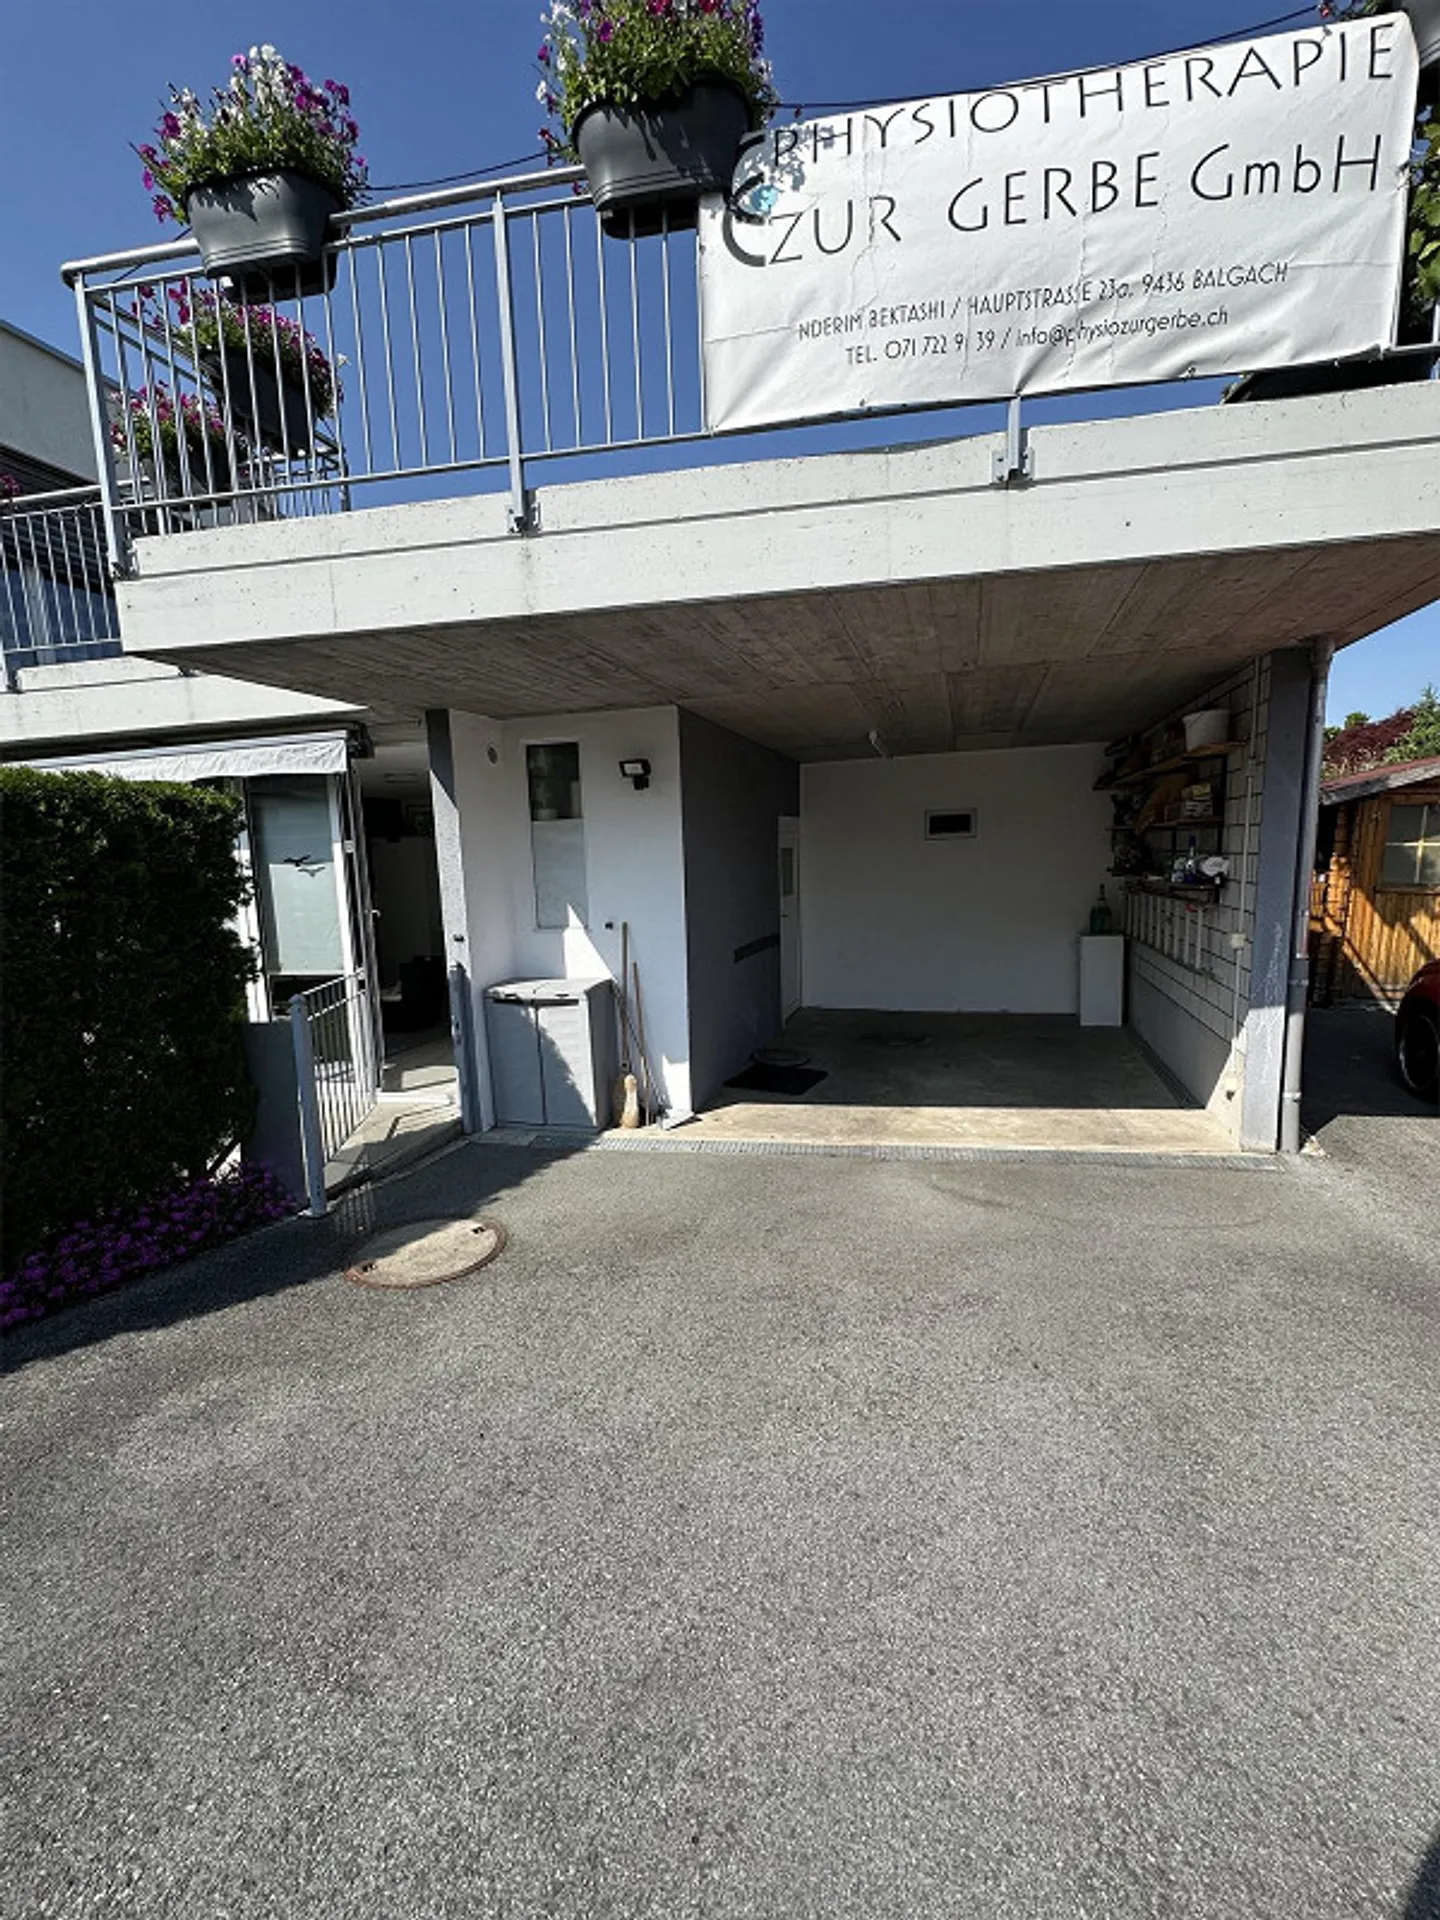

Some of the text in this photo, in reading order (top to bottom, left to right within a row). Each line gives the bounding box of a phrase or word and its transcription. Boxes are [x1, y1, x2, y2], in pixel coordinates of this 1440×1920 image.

[774, 22, 1393, 166] PHYSIOTHERAPIE
[769, 134, 1382, 265] ZUR GERBE GmbH
[799, 315, 863, 340] NDERIM
[869, 301, 945, 328] BEKTASHI
[969, 280, 1091, 314] HAUPTSTRASSE
[1142, 273, 1186, 294] 9436
[1192, 262, 1288, 289] BALGACH
[846, 344, 878, 365] TEL.
[921, 335, 947, 356] 722
[976, 329, 995, 351] 39
